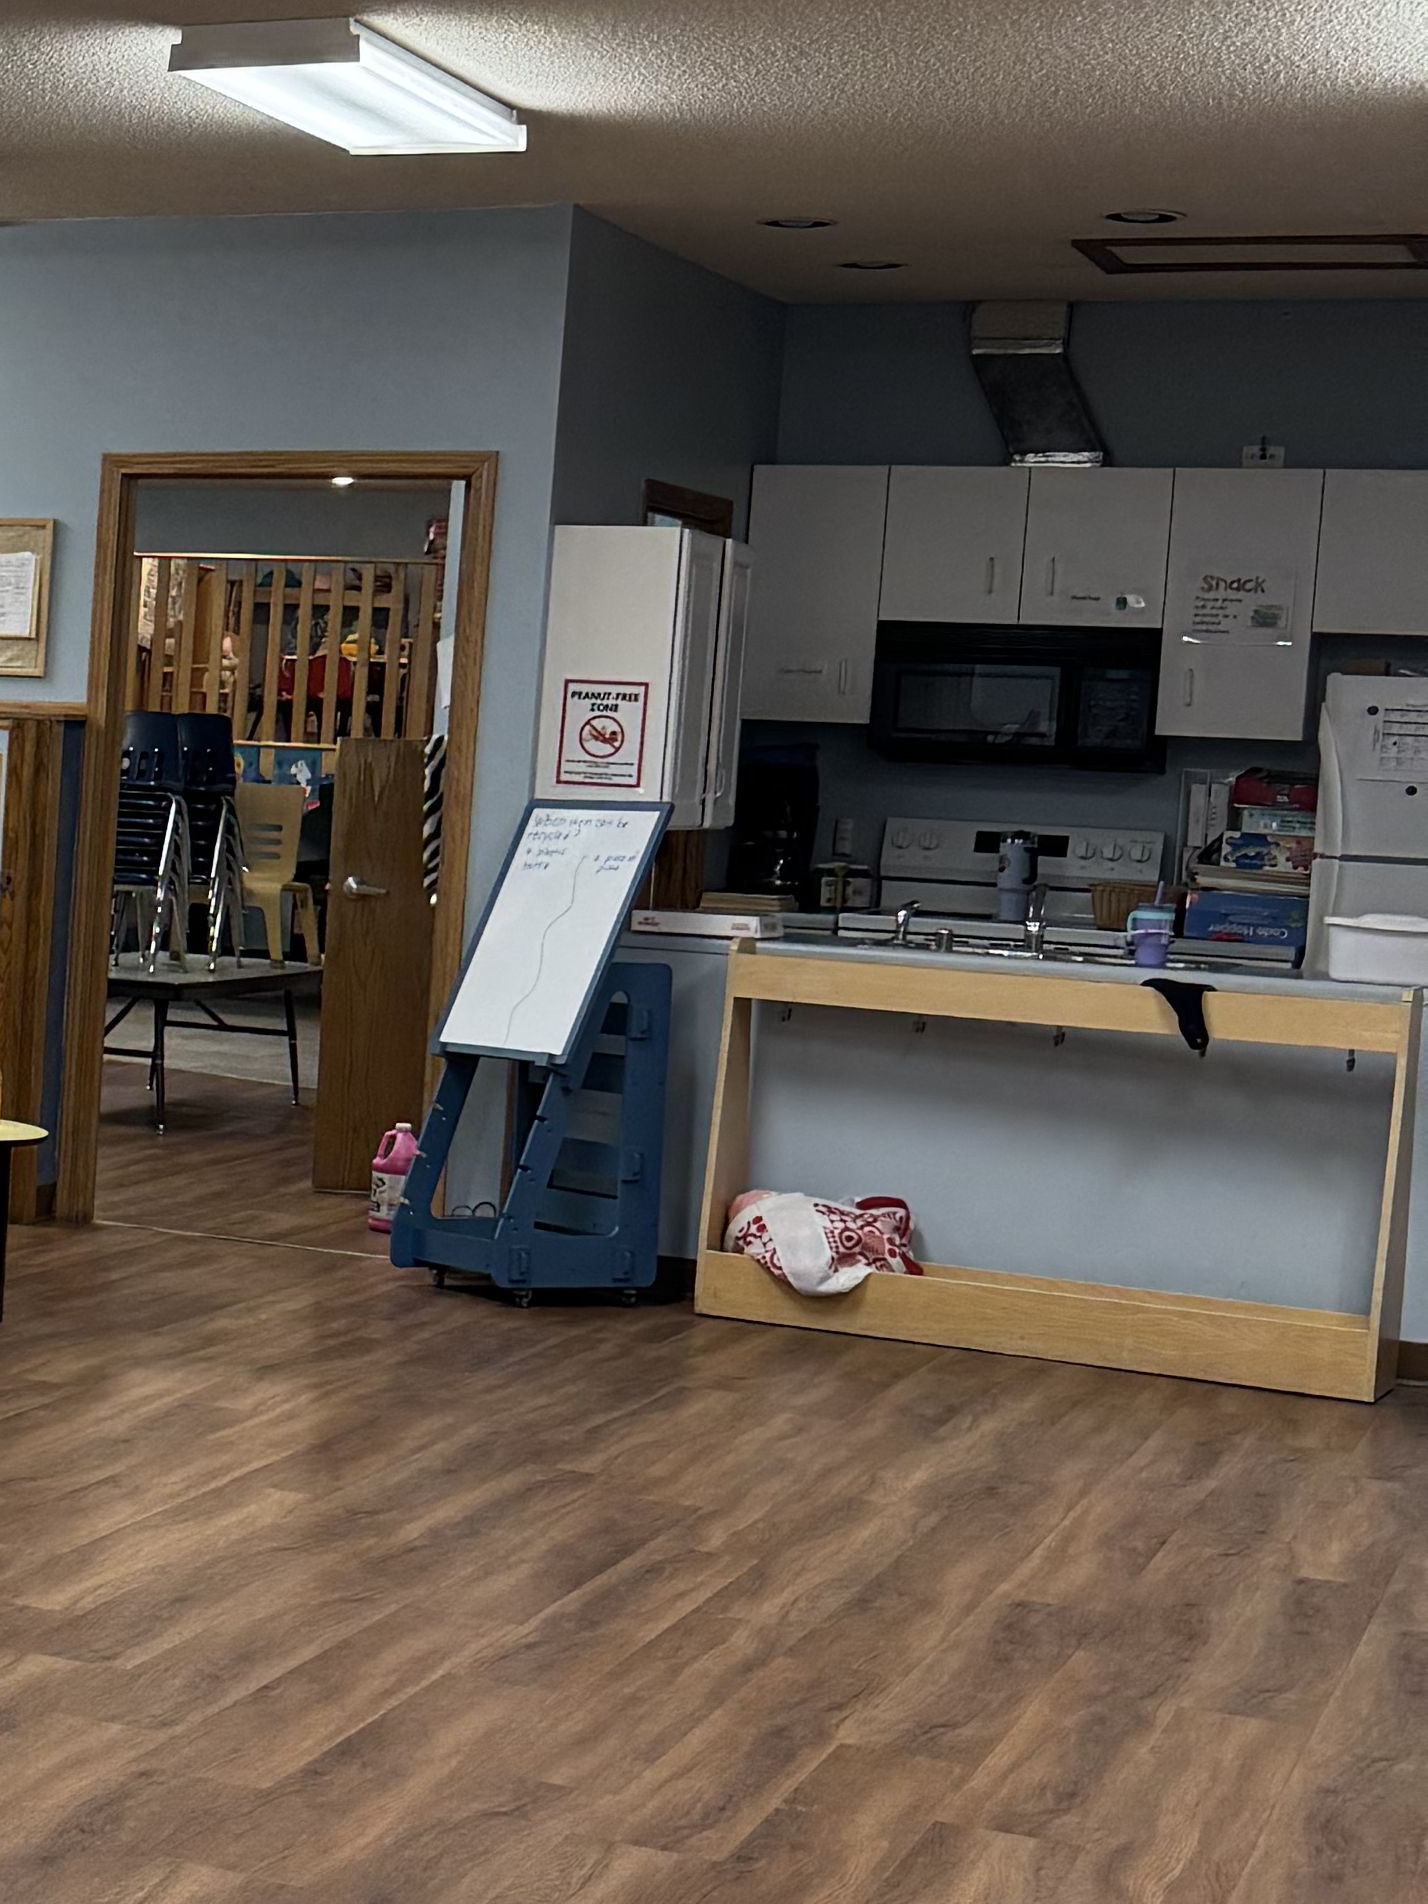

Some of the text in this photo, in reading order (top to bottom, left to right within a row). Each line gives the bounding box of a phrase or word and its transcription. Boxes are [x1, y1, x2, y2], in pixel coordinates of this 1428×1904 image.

[1200, 575, 1266, 594] Snack
[571, 690, 640, 703] PEANUT-FREE
[589, 702, 619, 713] ZONE
